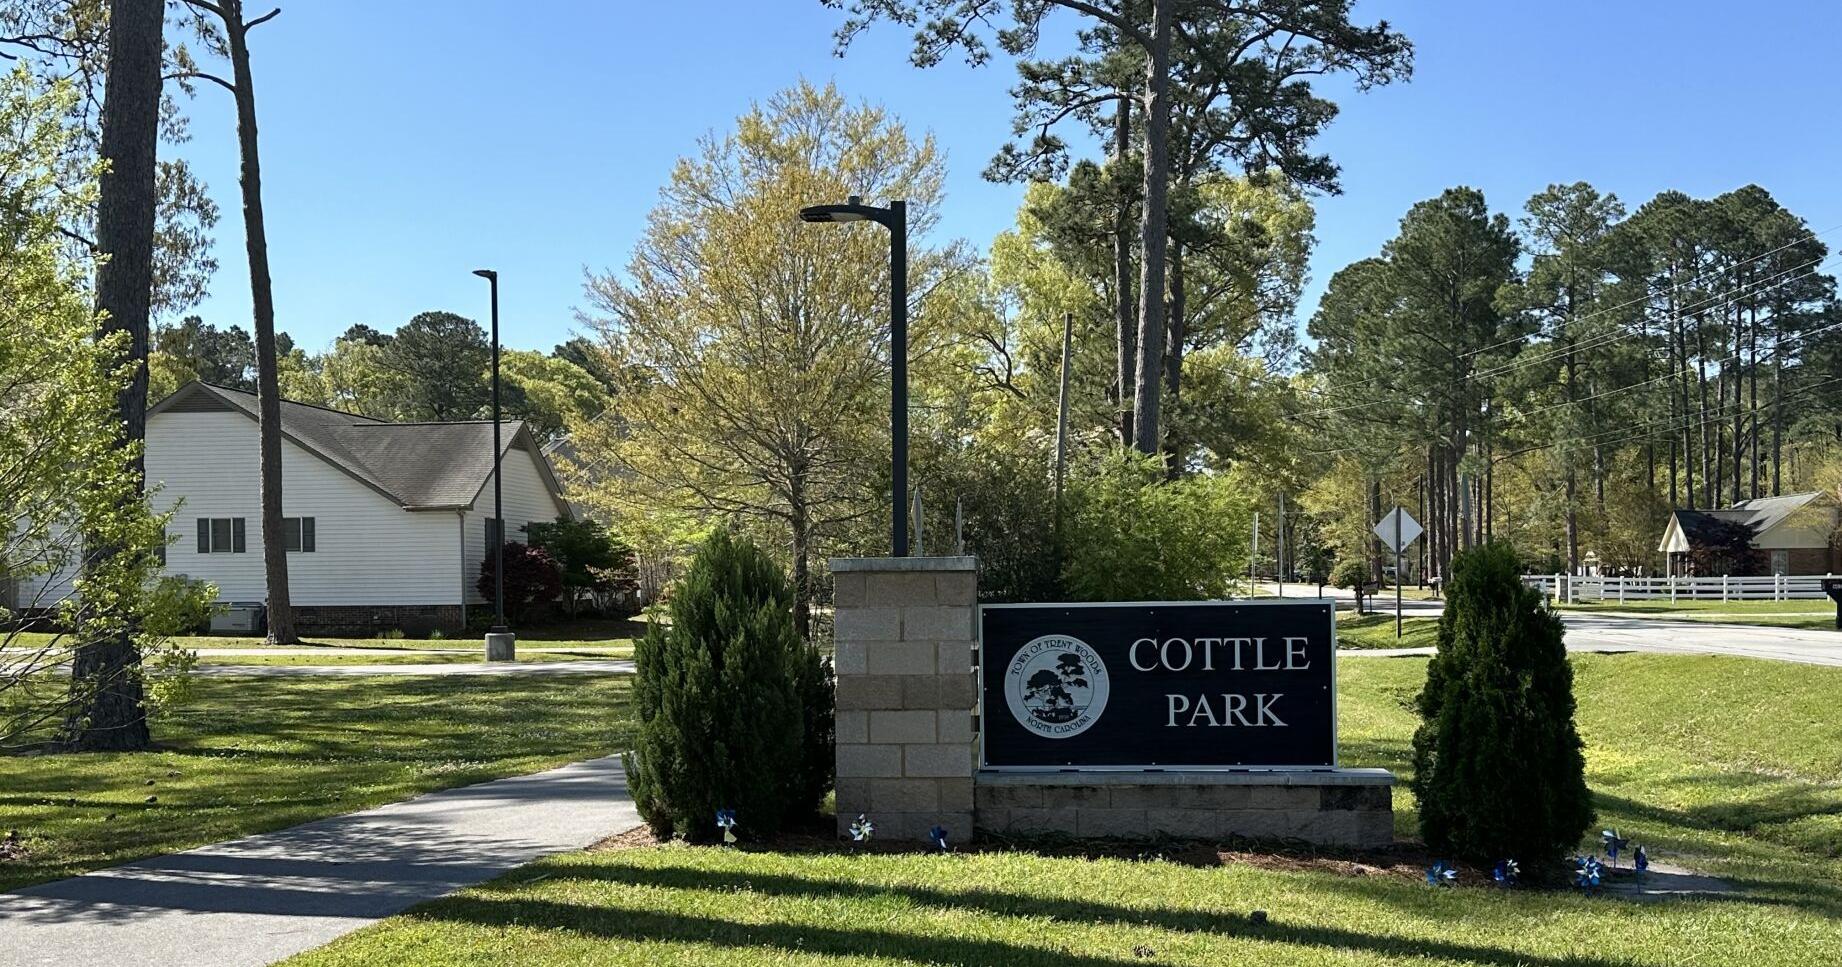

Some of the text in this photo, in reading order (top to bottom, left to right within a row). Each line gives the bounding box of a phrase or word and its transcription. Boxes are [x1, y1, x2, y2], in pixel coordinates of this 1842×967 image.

[1011, 640, 1102, 675] TOWN OF TRENT WOODS
[1129, 637, 1311, 672] COTTLE
[1026, 715, 1091, 733] NORTH CAROLINA
[1164, 693, 1289, 727] PARK
